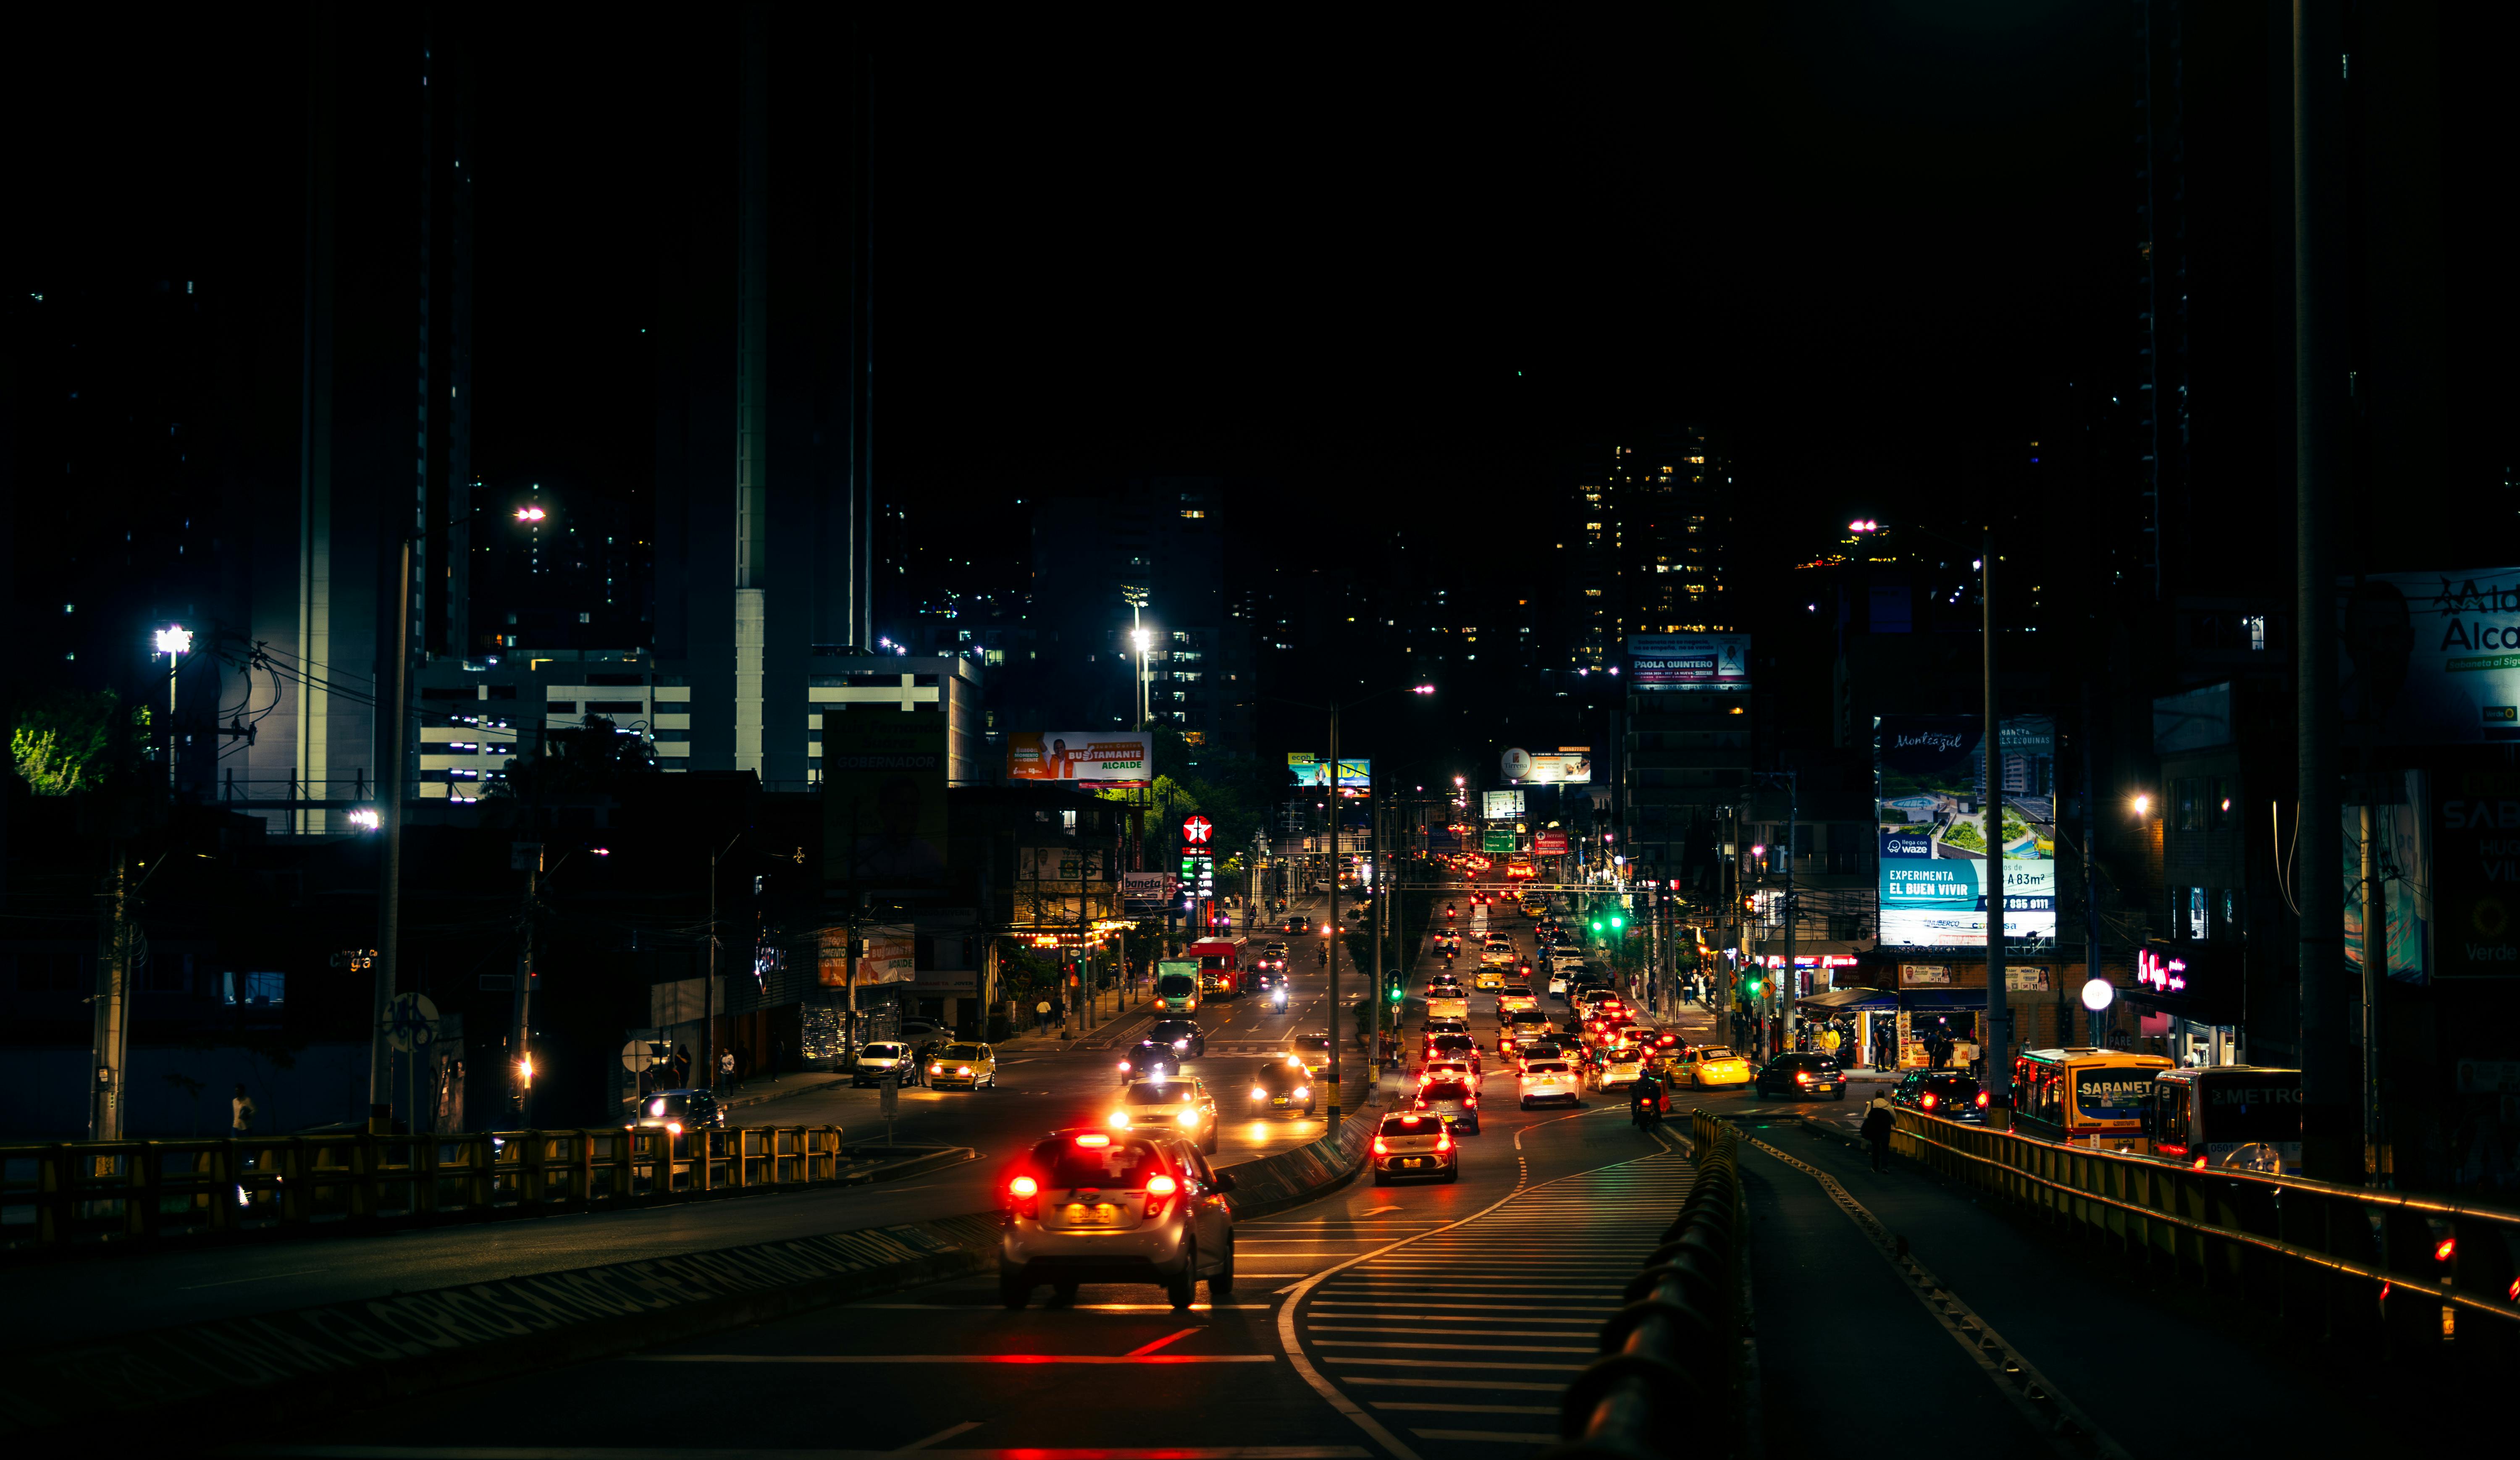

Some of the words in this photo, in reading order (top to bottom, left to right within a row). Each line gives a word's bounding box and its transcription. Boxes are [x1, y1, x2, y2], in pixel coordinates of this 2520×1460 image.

[2449, 660, 2491, 669] Sabaneta
[2013, 737, 2050, 745] ESQUINAS
[837, 756, 935, 768] GOBERNADOR
[1890, 870, 1953, 881] EXPERIMENTA
[2008, 874, 2014, 884] A
[1126, 878, 1161, 887] baneta
[1890, 883, 1903, 894] EL
[1906, 883, 1935, 895] BUEN
[1938, 883, 1968, 895] VIVIR
[2030, 899, 2048, 909] 9111
[2465, 942, 2518, 962] Verde
[2110, 1036, 2132, 1046] PARE
[2210, 1144, 2234, 1152] 0501
[299, 1282, 594, 1359] GLORIOSA
